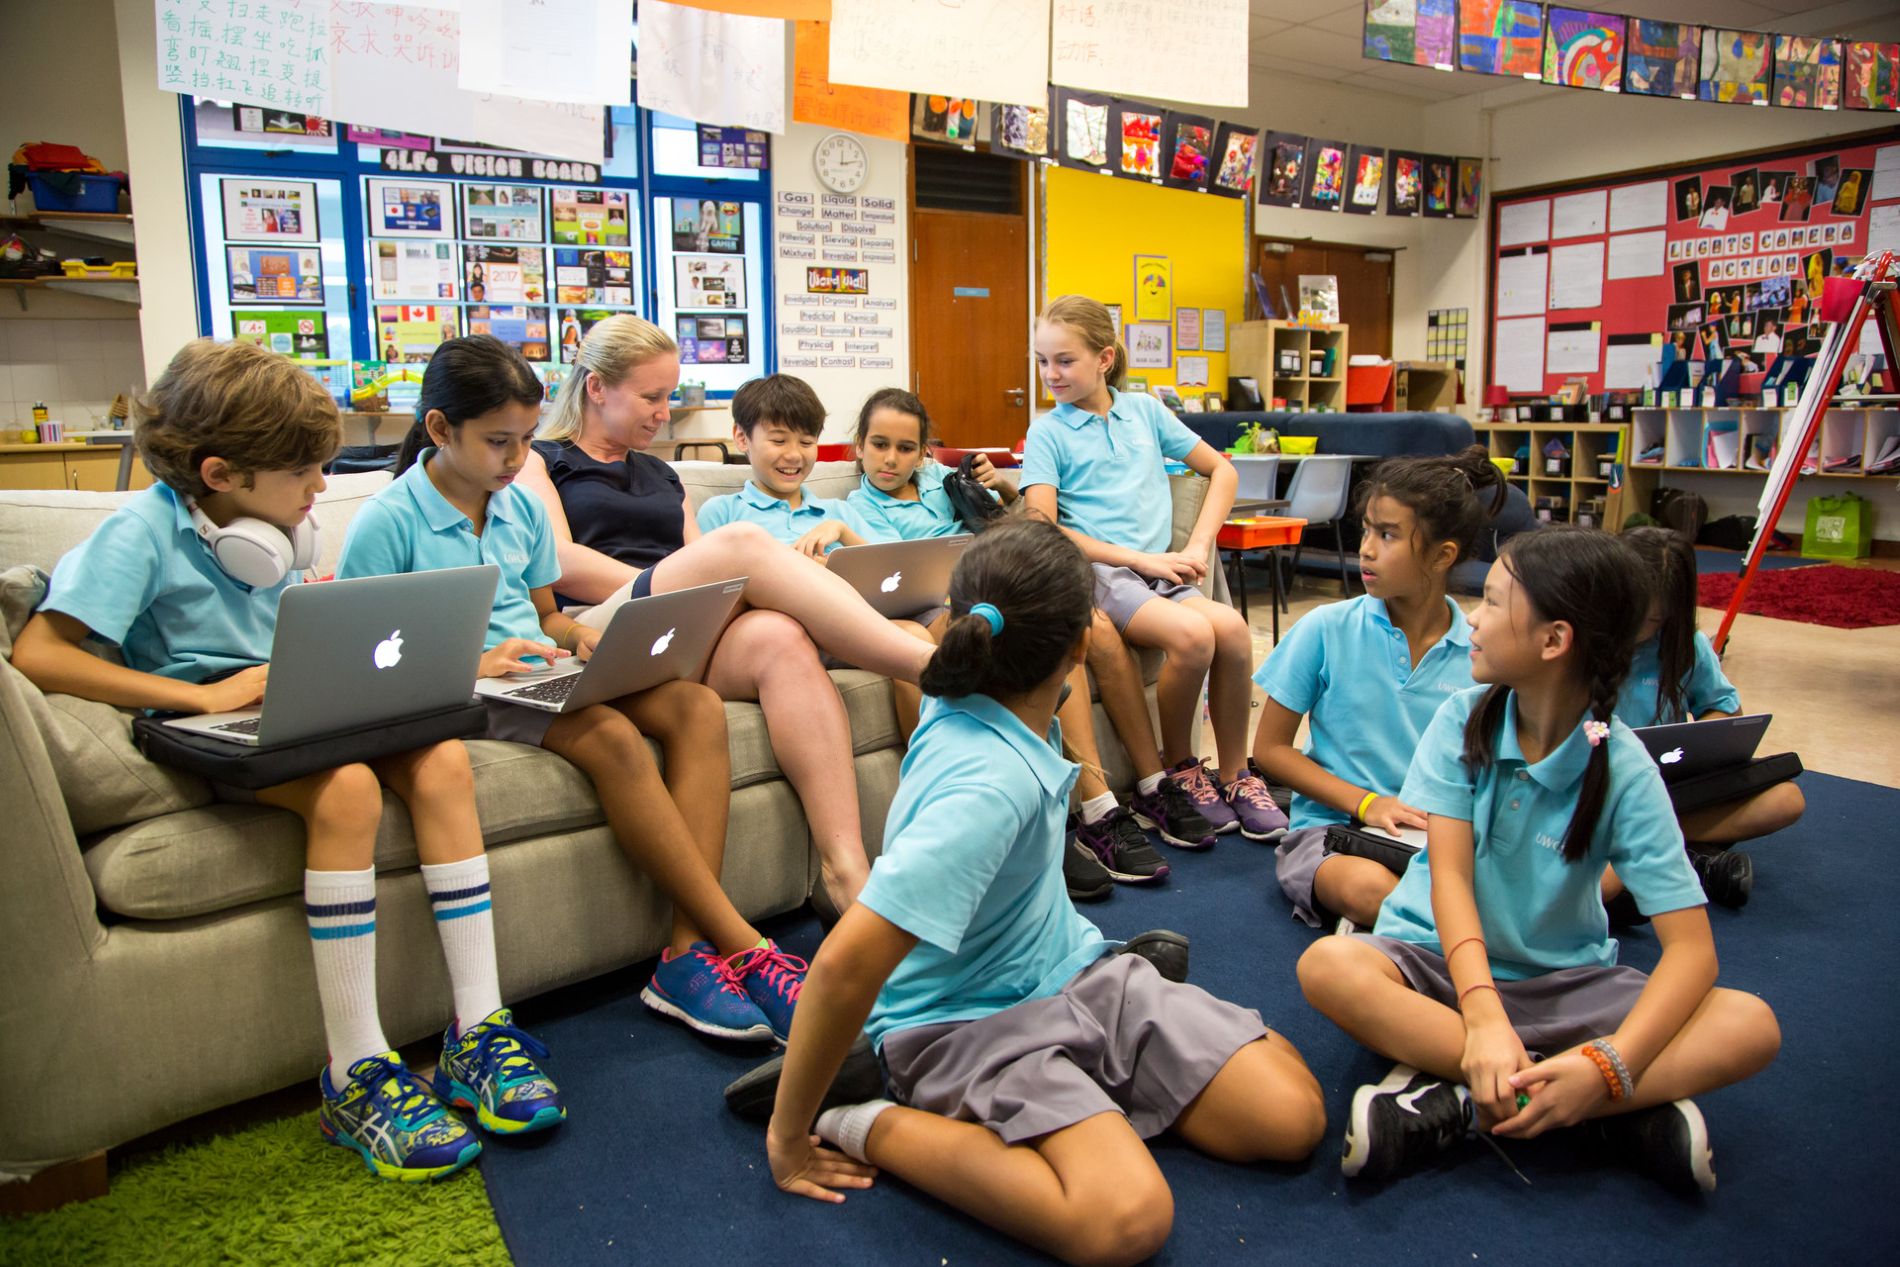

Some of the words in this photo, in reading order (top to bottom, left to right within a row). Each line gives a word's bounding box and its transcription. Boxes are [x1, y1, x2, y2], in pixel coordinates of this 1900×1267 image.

[450, 154, 523, 177] VISION
[532, 159, 597, 182] BOARD
[784, 192, 808, 202] Gas
[824, 195, 855, 205] Liquid
[864, 198, 893, 209] Solid
[780, 207, 812, 217] Change
[824, 210, 854, 218] Matter
[799, 221, 830, 231] Solution
[843, 223, 874, 233] Dissolve
[824, 235, 855, 245] Sieving
[1761, 224, 1852, 248] CAMERA
[782, 249, 813, 257] Mixture
[1711, 256, 1796, 278] ACTION
[493, 270, 518, 282] 2017
[809, 271, 840, 288] Word
[843, 271, 867, 289] Wall
[800, 341, 833, 349] Physical
[823, 357, 853, 365] Contrast
